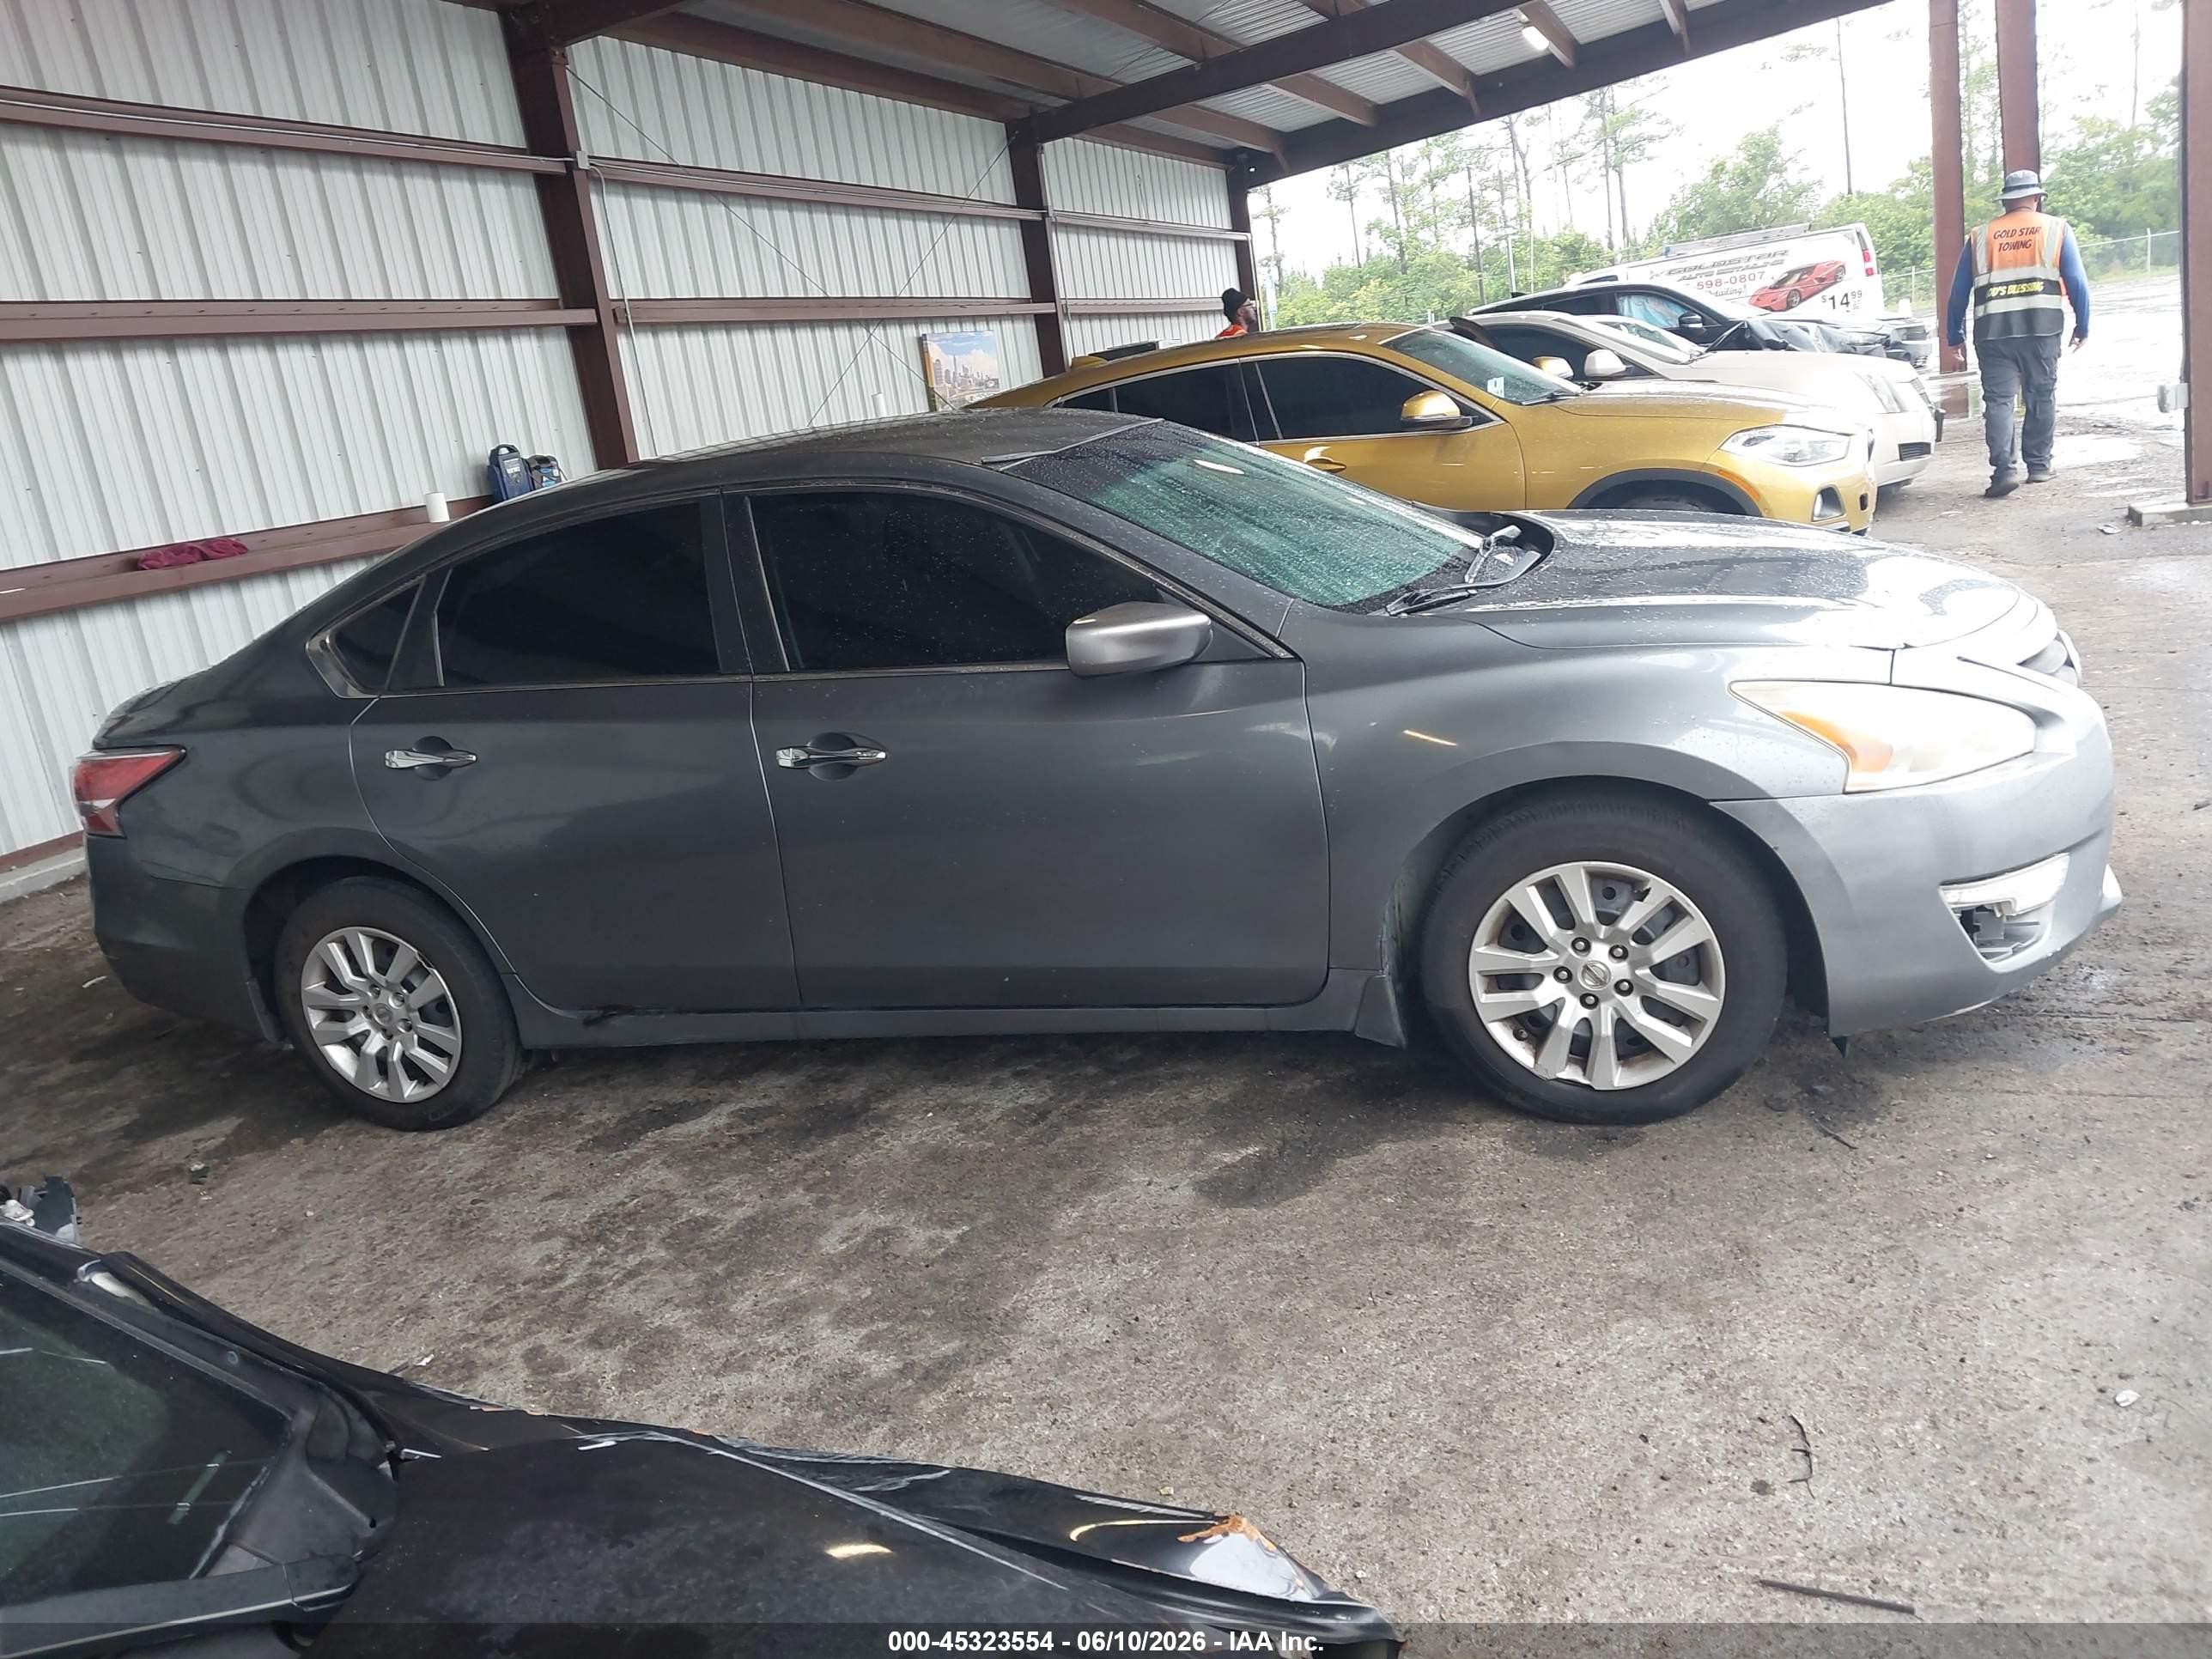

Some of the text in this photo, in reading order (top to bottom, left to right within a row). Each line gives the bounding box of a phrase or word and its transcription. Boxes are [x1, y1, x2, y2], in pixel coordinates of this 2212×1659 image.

[1993, 228, 2017, 240] GOLD
[1998, 239, 2033, 252] TOWING
[1696, 270, 1765, 290] 598-0807
[1986, 285, 2008, 297] OD'S
